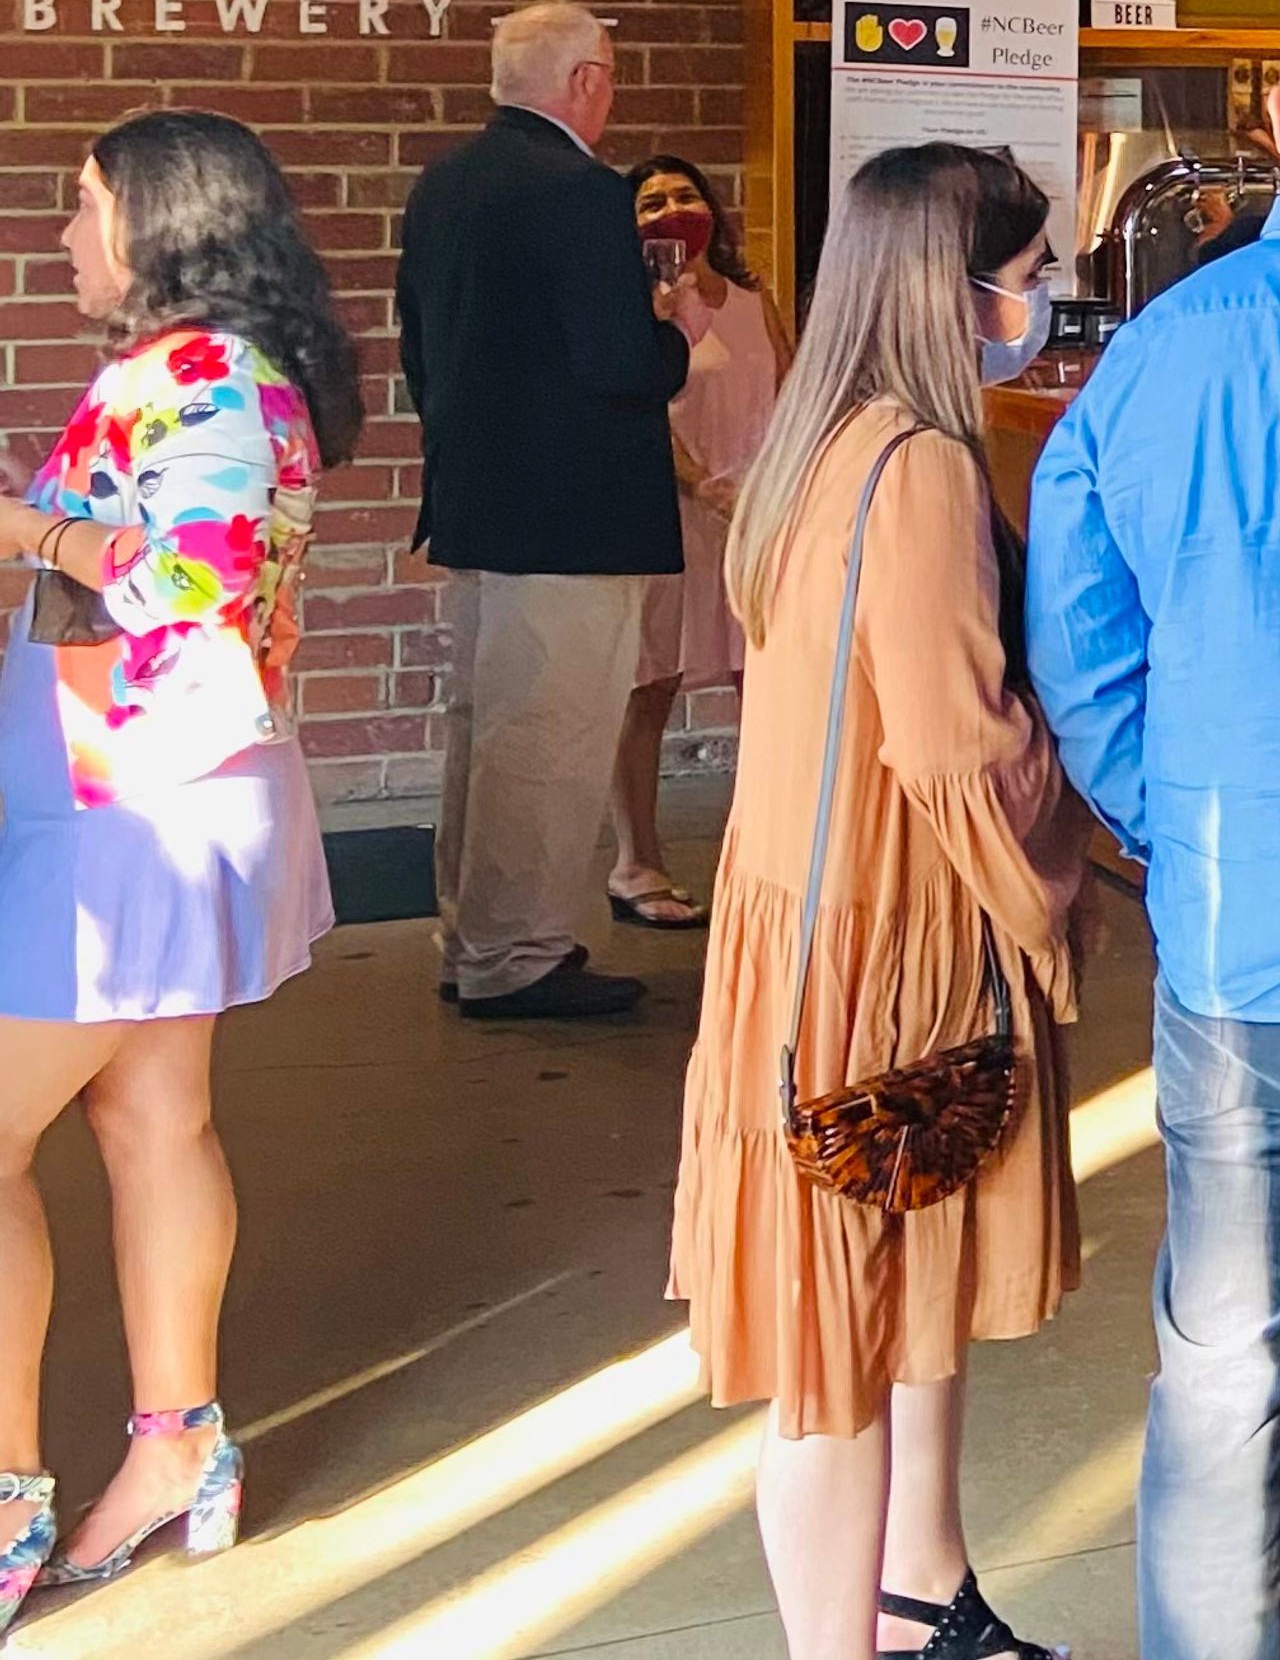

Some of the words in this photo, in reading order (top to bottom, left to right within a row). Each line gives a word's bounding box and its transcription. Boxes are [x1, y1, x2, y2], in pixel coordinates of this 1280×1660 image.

[980, 15, 1065, 36] #NCBeer
[1115, 4, 1153, 26] BEER
[992, 47, 1053, 71] Pledge
